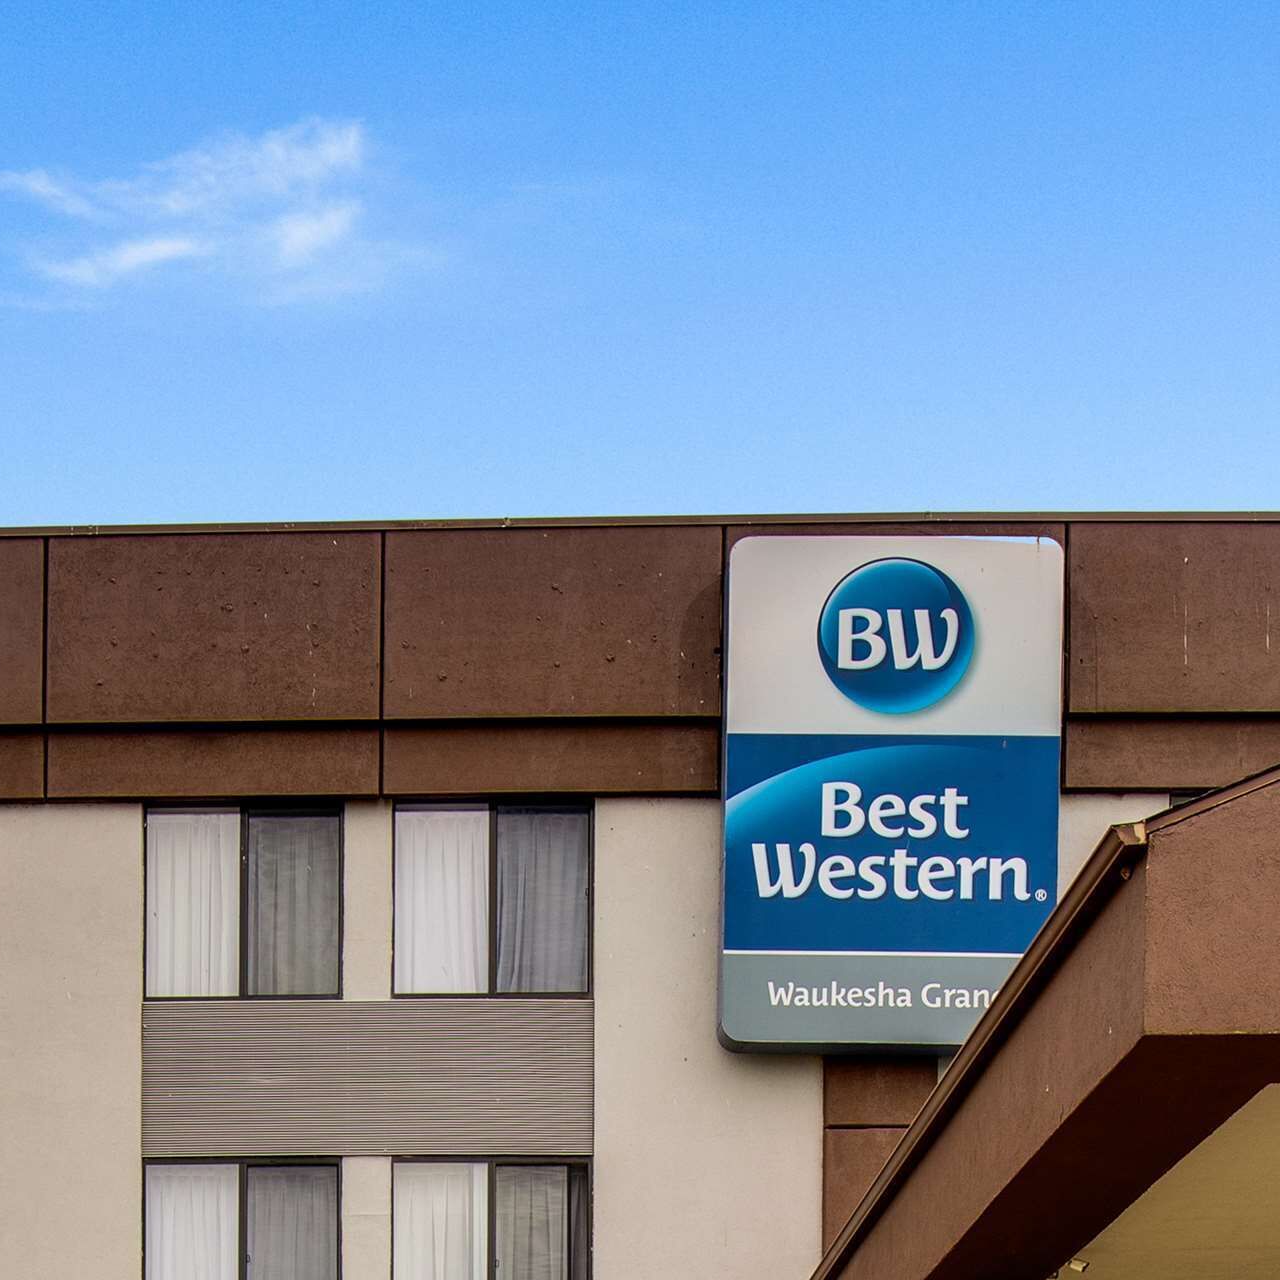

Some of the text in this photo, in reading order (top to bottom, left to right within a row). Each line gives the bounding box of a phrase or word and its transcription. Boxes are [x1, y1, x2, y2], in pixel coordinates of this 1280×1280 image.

[837, 607, 960, 672] BW
[820, 781, 970, 839] Best
[767, 980, 999, 1009] Waukesha Gran
